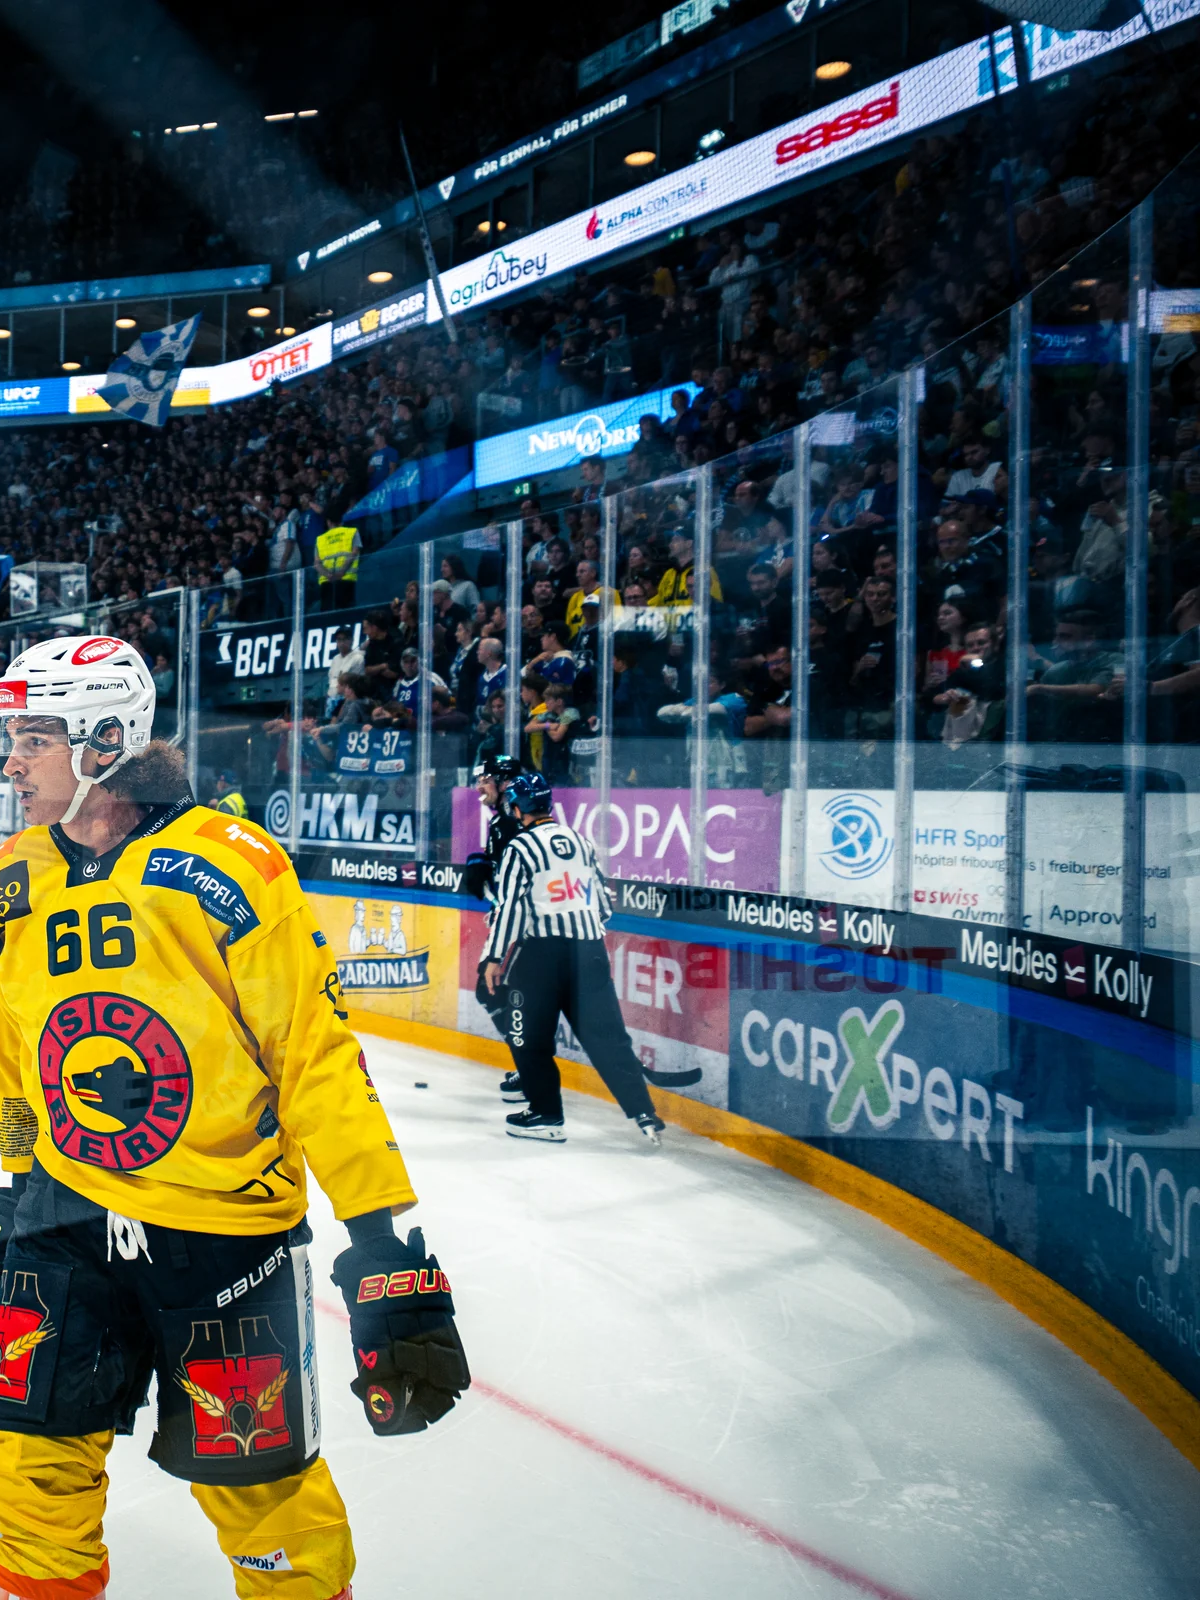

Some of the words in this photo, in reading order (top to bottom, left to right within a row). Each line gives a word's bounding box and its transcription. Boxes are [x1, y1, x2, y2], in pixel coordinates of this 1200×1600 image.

[776, 81, 900, 165] sassi
[474, 160, 499, 180] FÜR
[553, 118, 580, 140] FÜR
[380, 293, 425, 325] EGGER
[251, 342, 313, 381] OTTET
[3, 386, 41, 401] UPCF
[234, 634, 284, 677] BCF
[347, 731, 369, 754] 93
[383, 731, 399, 756] 37
[298, 791, 378, 842] HKM
[380, 814, 414, 844] SA
[553, 838, 572, 855] 57
[915, 828, 957, 847] HFR
[332, 858, 398, 882] Meubles
[422, 865, 463, 893] Kolly
[914, 854, 957, 868] hôpital
[1049, 859, 1122, 879] freiburger
[547, 872, 592, 905] sky
[622, 884, 667, 918] Kolly
[929, 887, 979, 906] swiss
[46, 902, 137, 977] 66
[727, 895, 815, 935] Meubles
[843, 909, 895, 954] Kolly
[961, 928, 1058, 984] Meubles
[1094, 953, 1154, 1018] Kolly
[509, 1009, 524, 1047] elco
[217, 1245, 289, 1308] BAUER
